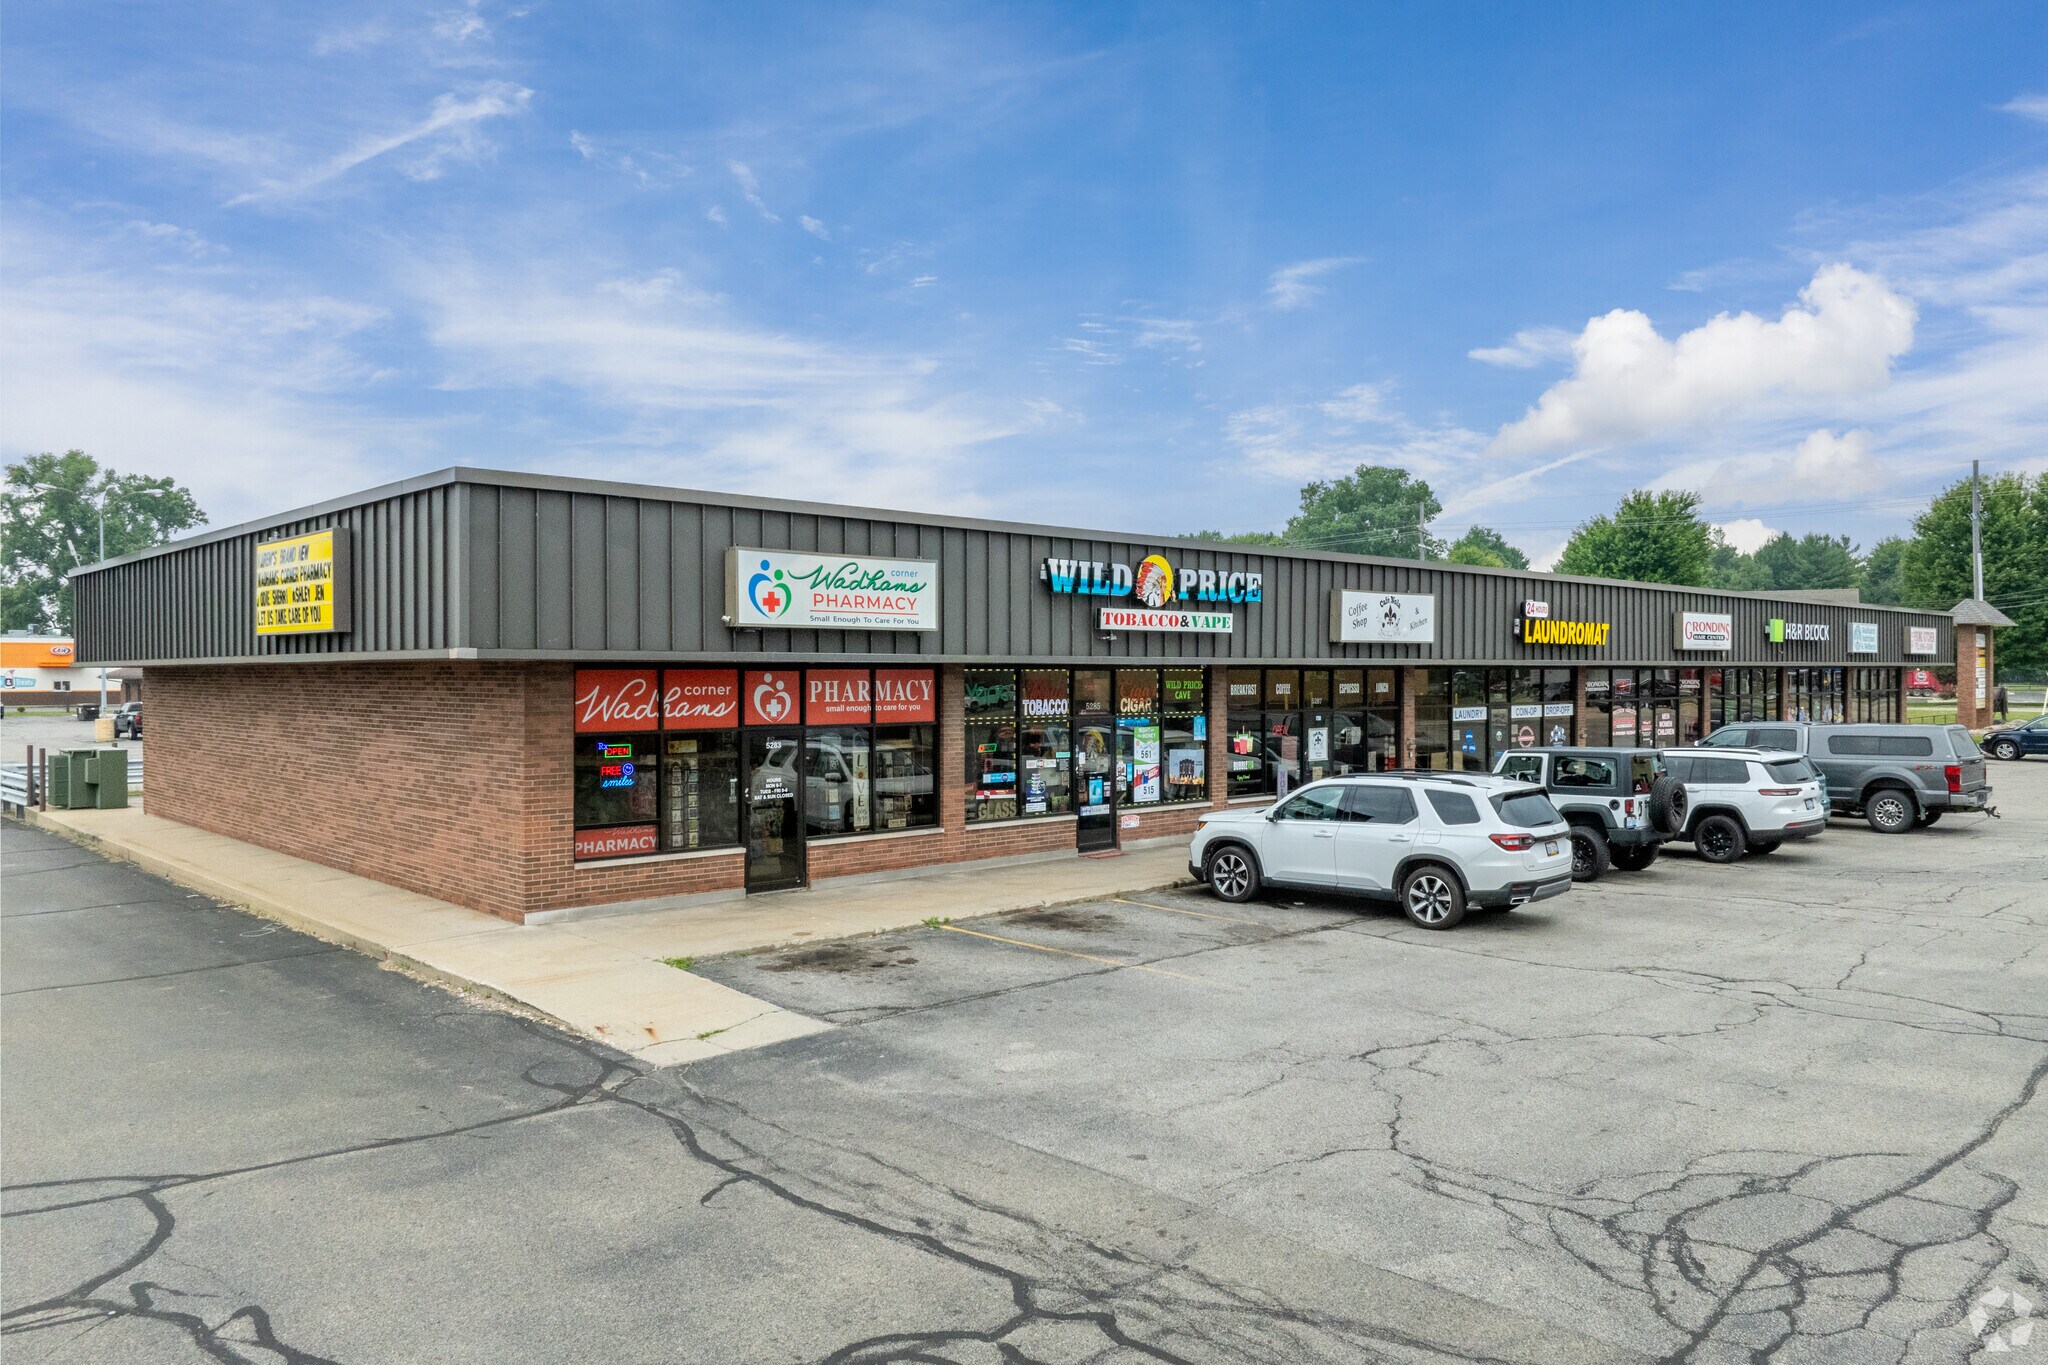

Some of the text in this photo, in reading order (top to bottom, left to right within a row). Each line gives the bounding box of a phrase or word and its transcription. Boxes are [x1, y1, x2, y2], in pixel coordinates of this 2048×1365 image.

[300, 562, 332, 581] PHARMACY
[787, 561, 927, 593] Wadhams
[891, 568, 918, 578] corner
[1048, 558, 1262, 604] WILD PRICE
[292, 585, 311, 603] ASHLEY
[315, 584, 325, 601] JEN
[813, 593, 917, 611] PHARMACY
[1348, 602, 1368, 617] Coffee
[1414, 607, 1420, 615] &
[1526, 602, 1548, 614] 24 HOURS
[258, 605, 321, 626] LET US TAKE CARE OF YOU
[833, 615, 861, 625] Enough
[1352, 617, 1368, 629] Shop
[1409, 617, 1428, 631] Kitchen
[1524, 619, 1610, 646] LAUNDROMAT
[1685, 621, 1730, 641] GRONDINS
[1785, 622, 1830, 641] H&R BLOCK
[1165, 680, 1202, 689] WILD PRICE
[1230, 684, 1257, 695] BREAKFAST
[1275, 683, 1291, 695] COFFEE
[1339, 683, 1360, 694] ESPRESSO
[1375, 682, 1389, 693] LUNCH
[684, 686, 731, 696] corner
[809, 679, 933, 703] PHARMACY
[1174, 690, 1191, 700] CAVE
[575, 678, 736, 724] Wadhams
[1120, 697, 1152, 713] CIGAR
[825, 704, 845, 713] small
[846, 704, 871, 713] enough
[1022, 698, 1068, 716] TOBACCO
[1515, 706, 1537, 716] COIN-OP
[1545, 705, 1570, 715] DROP-OFF
[1454, 709, 1484, 720] LAUNDRY
[1661, 712, 1670, 720] MEN
[1659, 720, 1673, 728] WOMEN
[1657, 728, 1675, 736] CHILDREN
[597, 742, 608, 750] Rx
[765, 741, 782, 749] 5283
[605, 747, 630, 756] OPEN
[1141, 750, 1152, 759] 561
[601, 765, 622, 776] FREE
[602, 774, 635, 788] smiles
[1143, 785, 1154, 795] 515
[977, 800, 1017, 820] GLASS
[575, 835, 657, 854] PHARMACY
